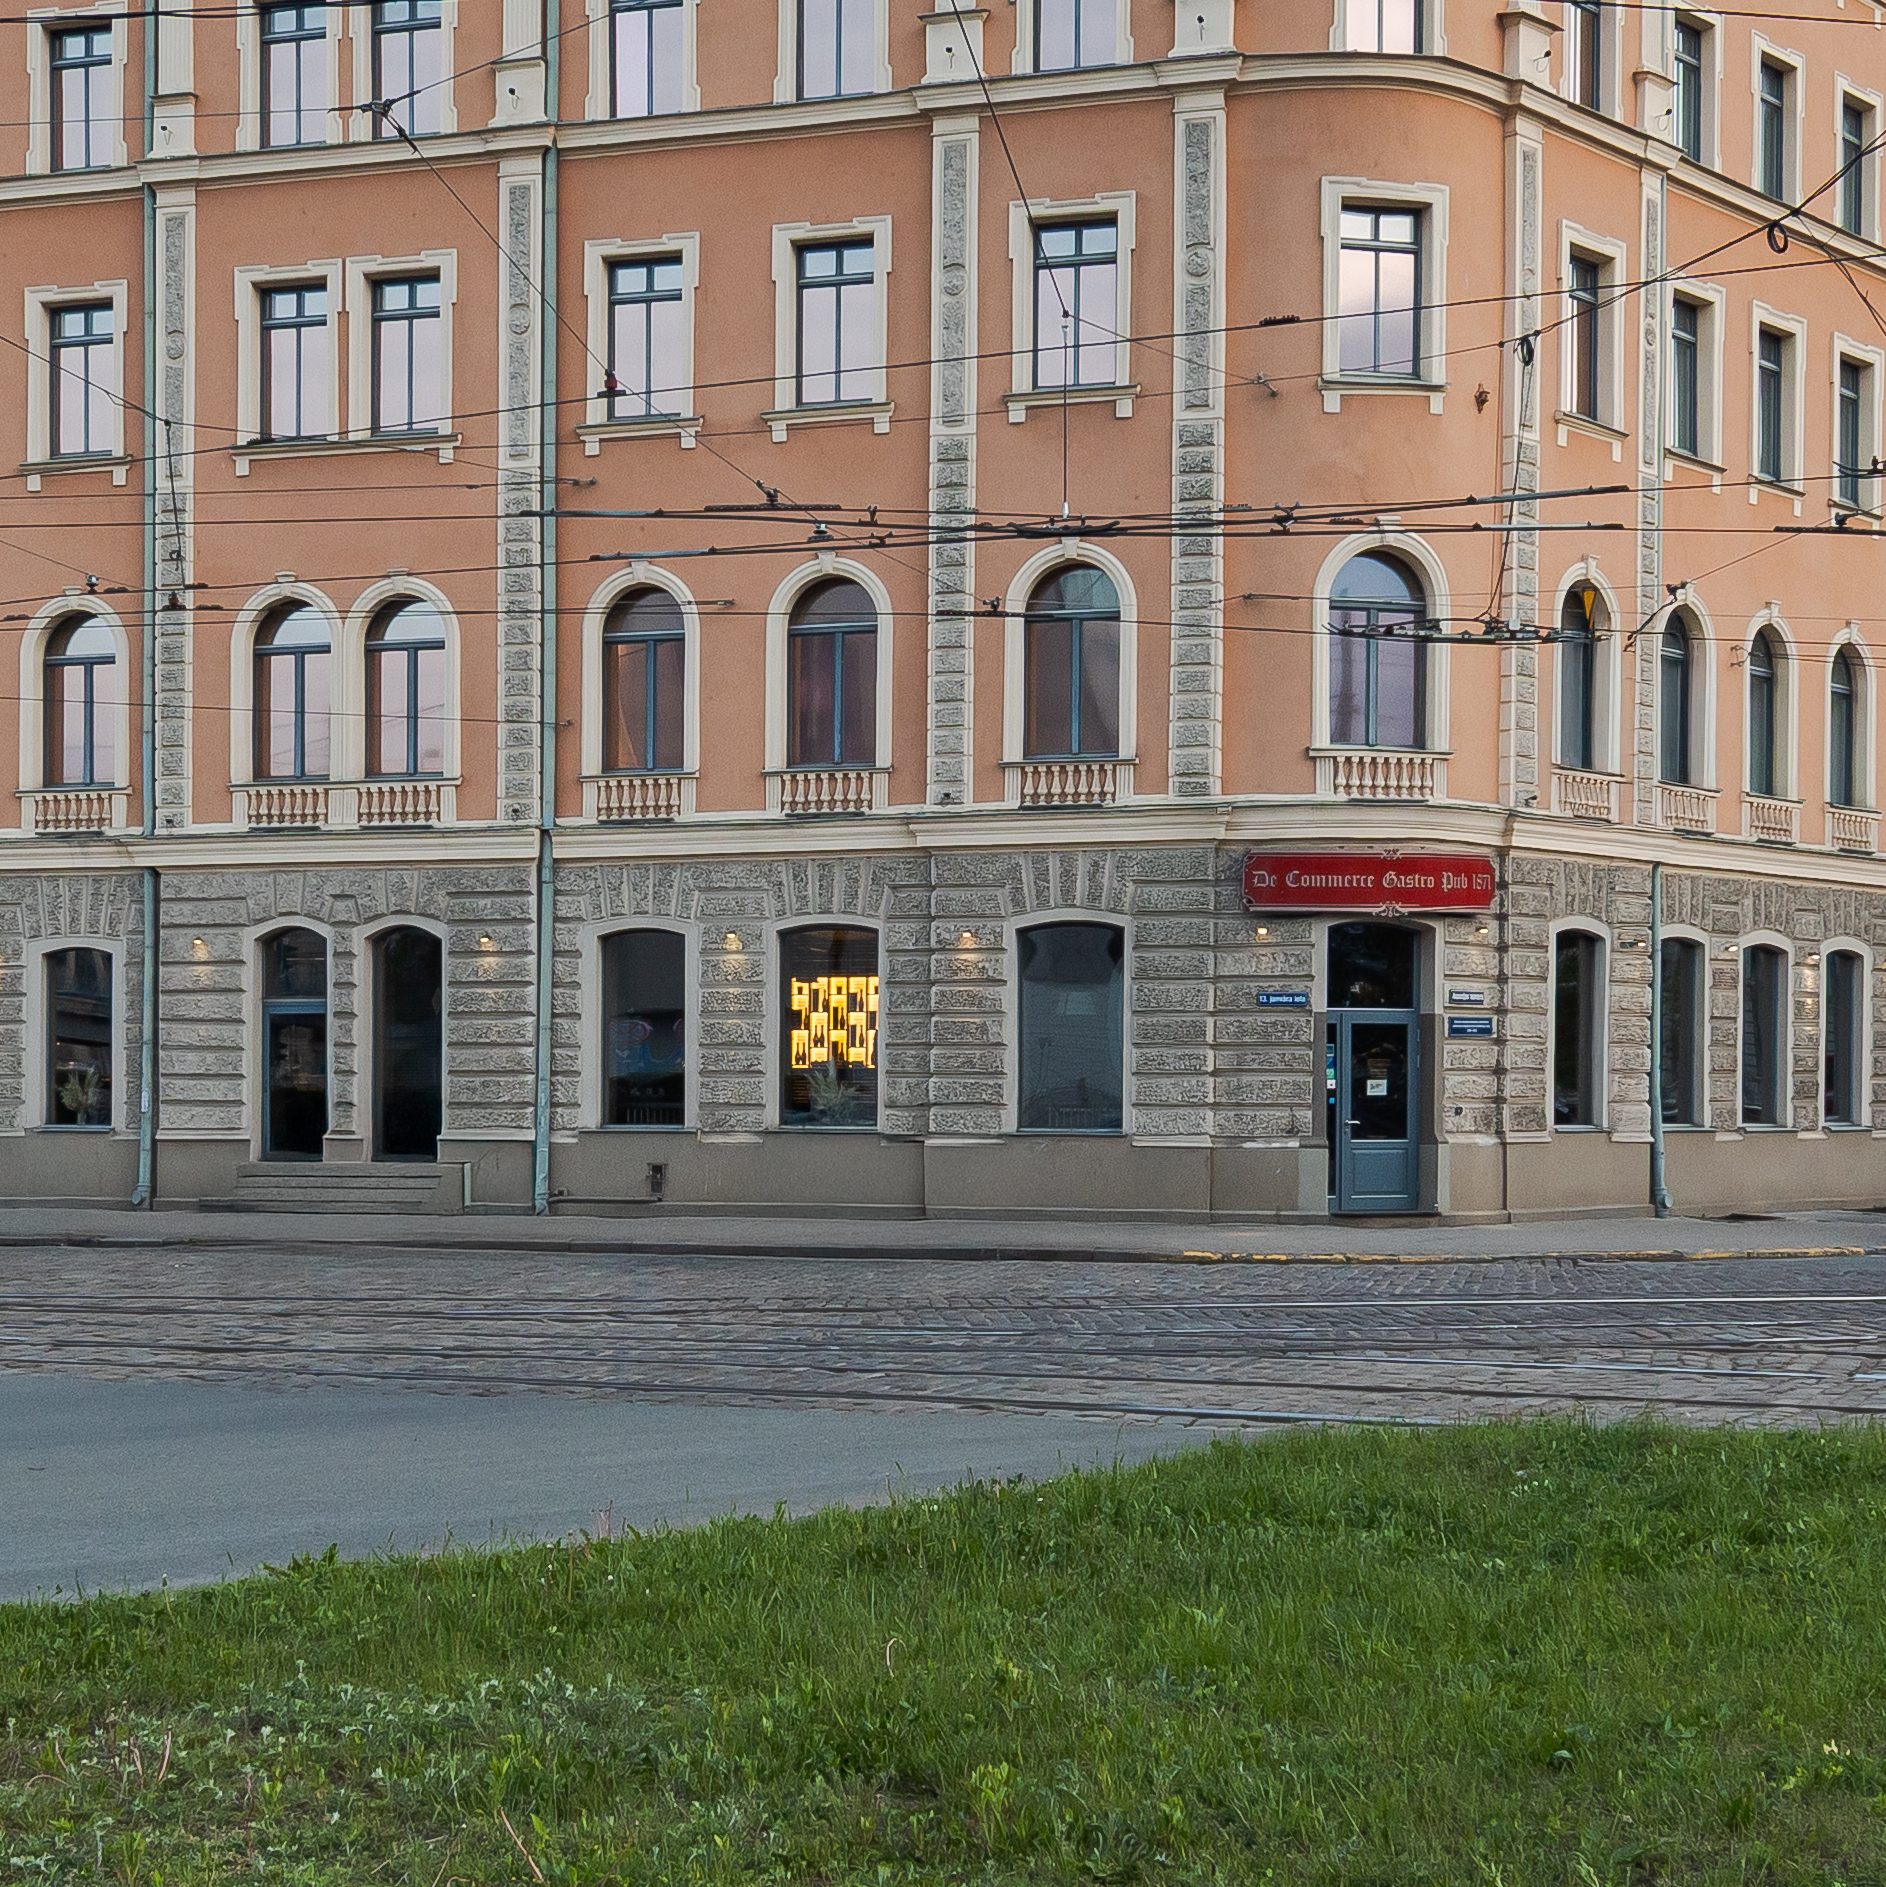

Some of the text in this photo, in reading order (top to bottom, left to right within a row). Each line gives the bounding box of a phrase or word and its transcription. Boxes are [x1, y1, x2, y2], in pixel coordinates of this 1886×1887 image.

[1251, 870, 1492, 893] De Commerce Gastro Pub 1871
